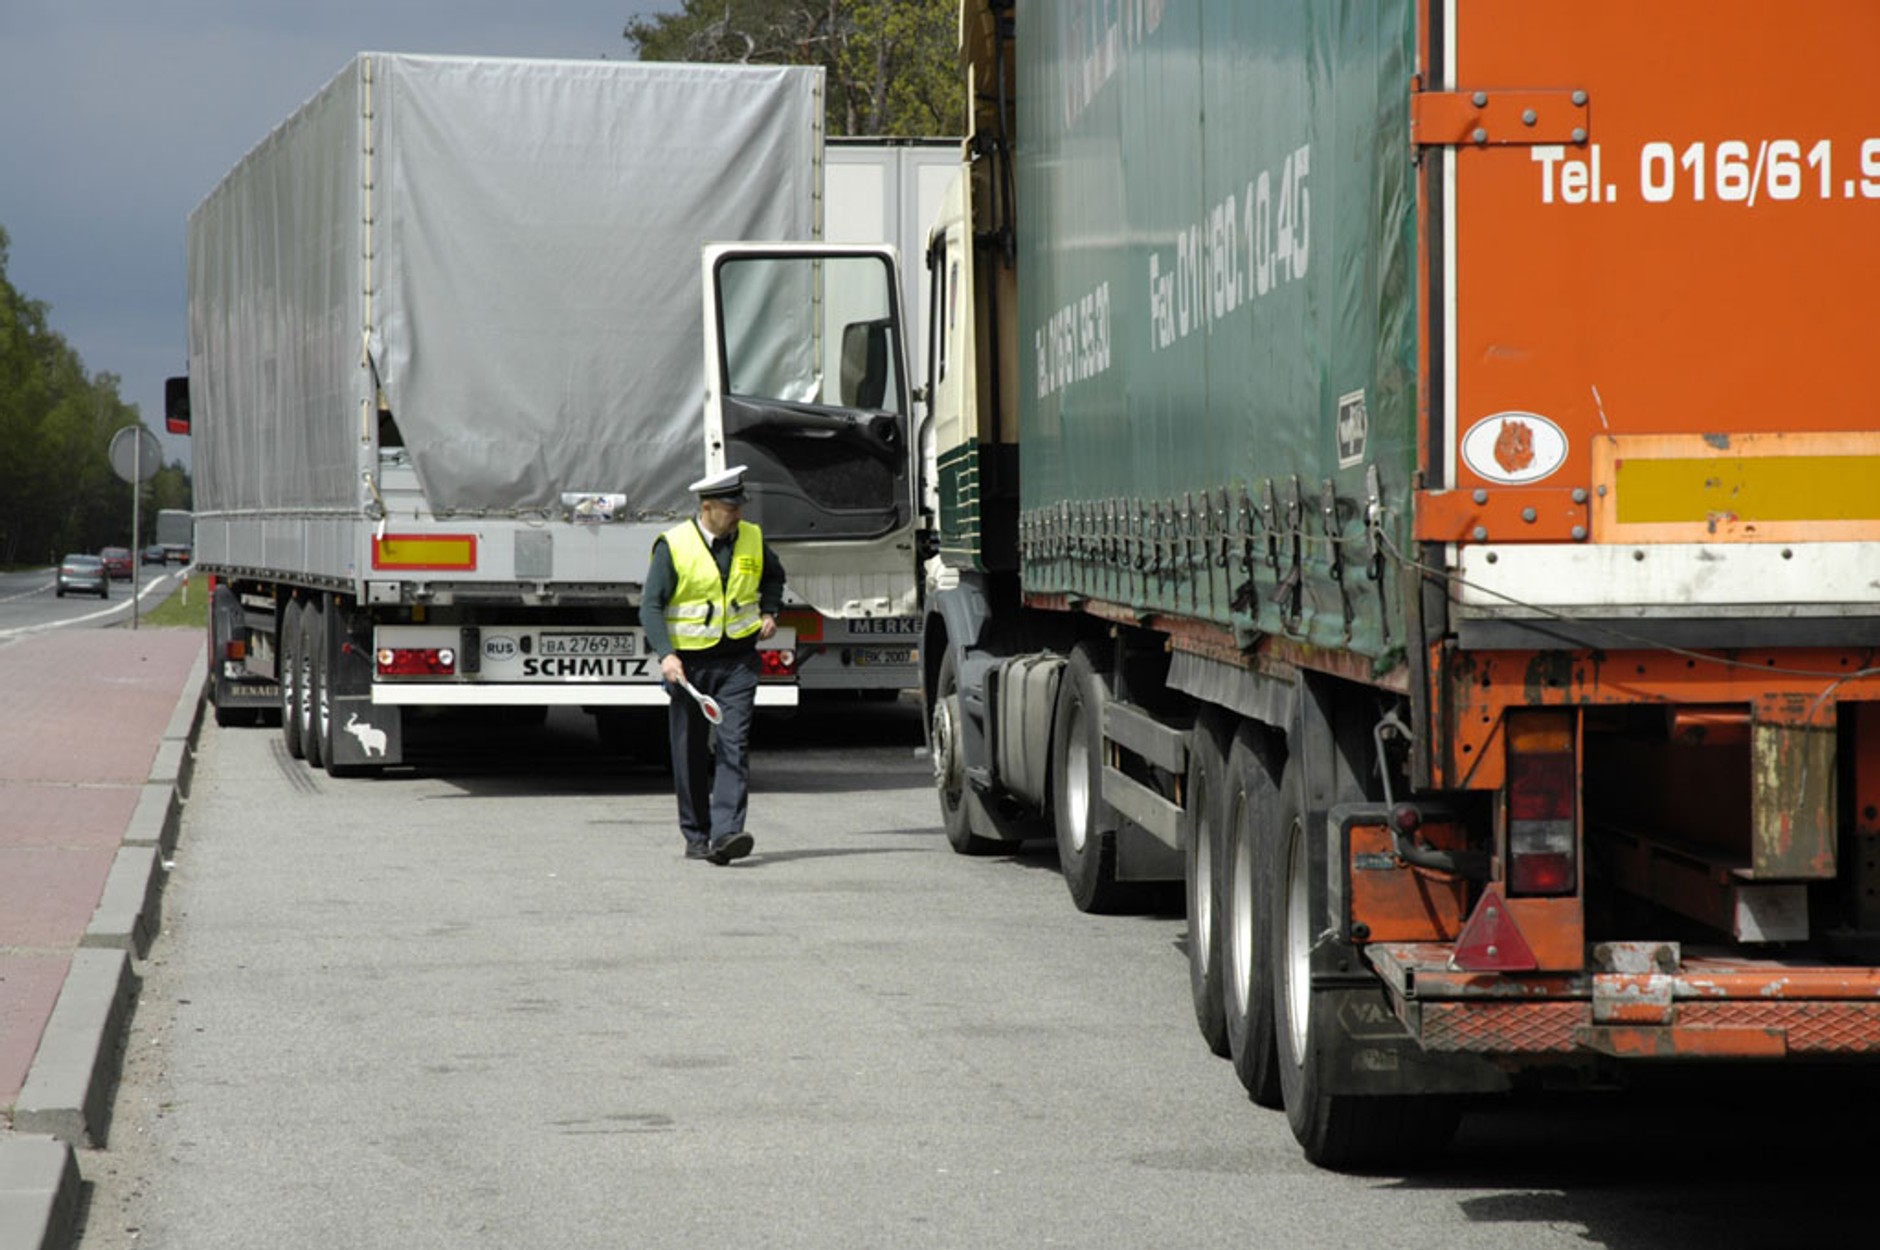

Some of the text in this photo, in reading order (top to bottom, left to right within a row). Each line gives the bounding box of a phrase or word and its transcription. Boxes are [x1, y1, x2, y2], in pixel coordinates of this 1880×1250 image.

[1531, 144, 1616, 203] Tel.
[1150, 252, 1176, 352] Fax
[486, 642, 514, 654] RUS
[570, 637, 609, 653] 2769
[523, 658, 650, 677] SCHMITZ
